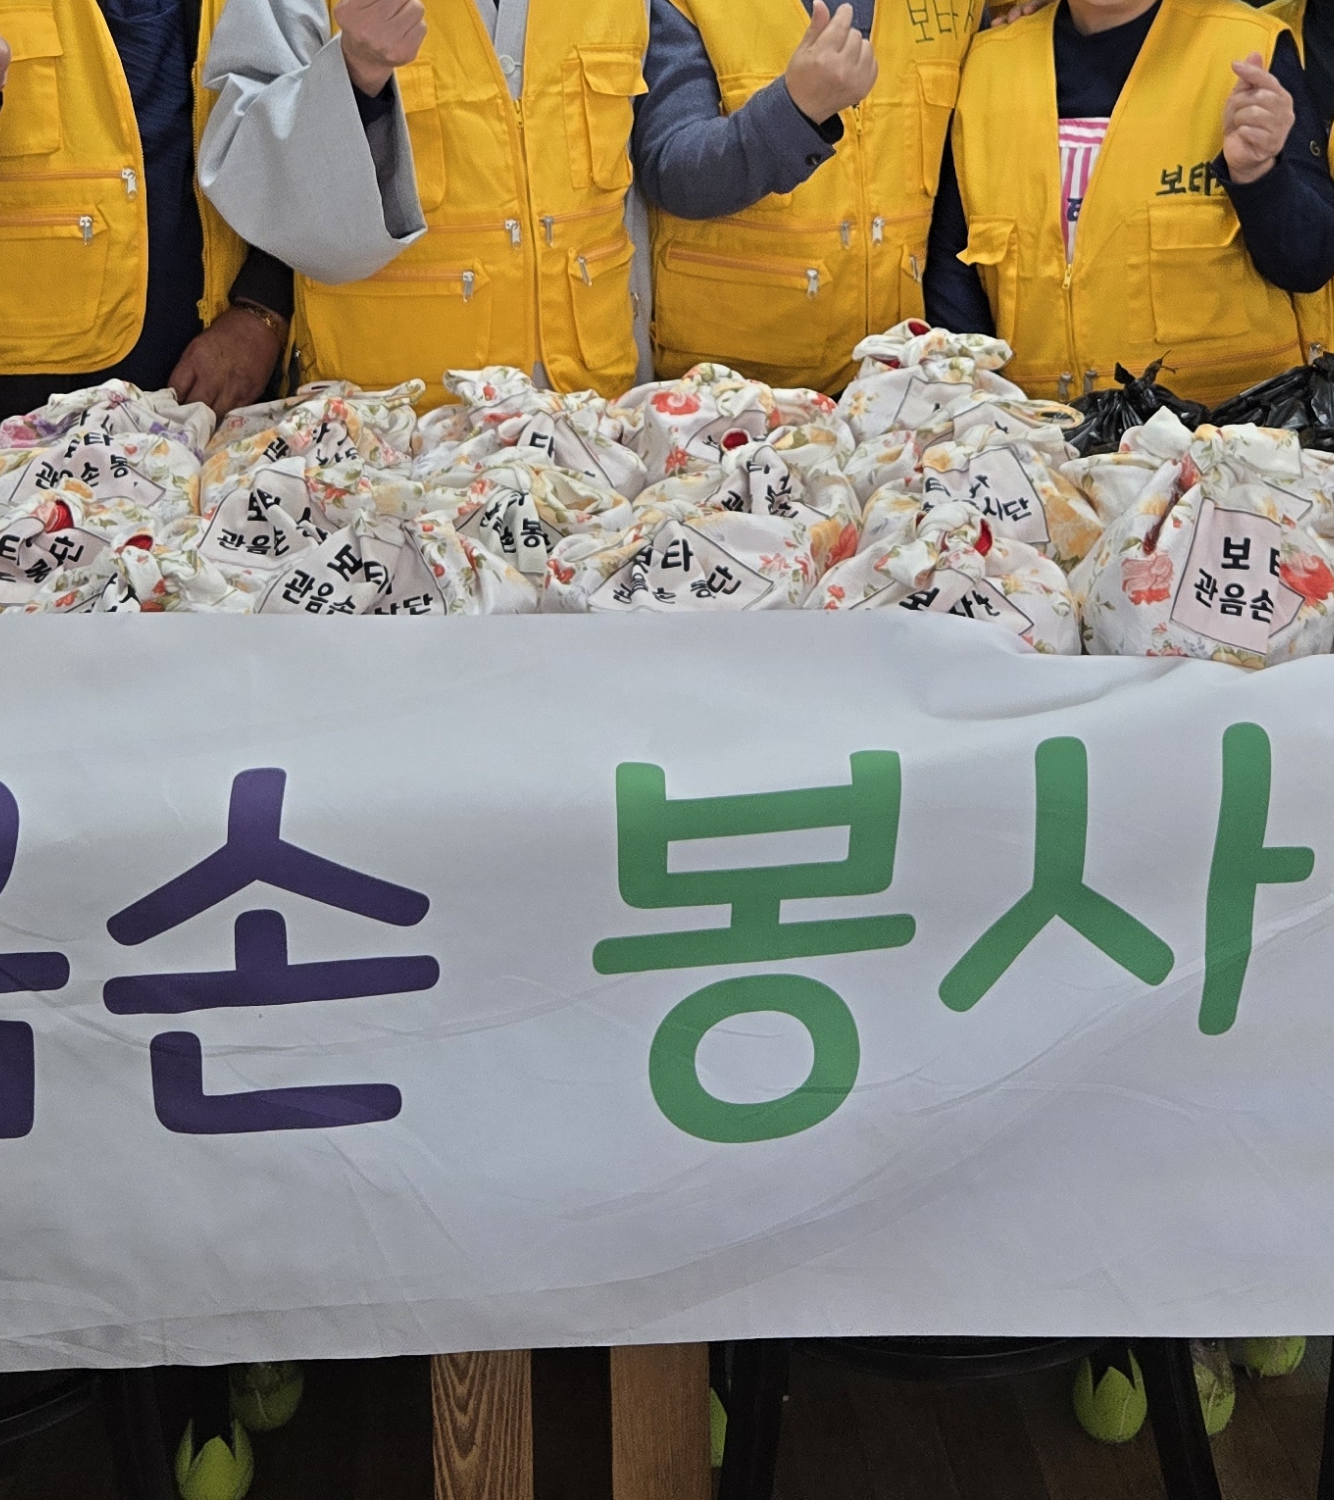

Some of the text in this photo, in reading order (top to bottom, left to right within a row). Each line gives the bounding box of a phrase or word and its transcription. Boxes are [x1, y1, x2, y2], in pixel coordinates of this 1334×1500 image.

[1156, 161, 1224, 197] 보타
[661, 538, 694, 573] 타
[1221, 536, 1252, 571] 보
[1194, 568, 1275, 624] 관음손
